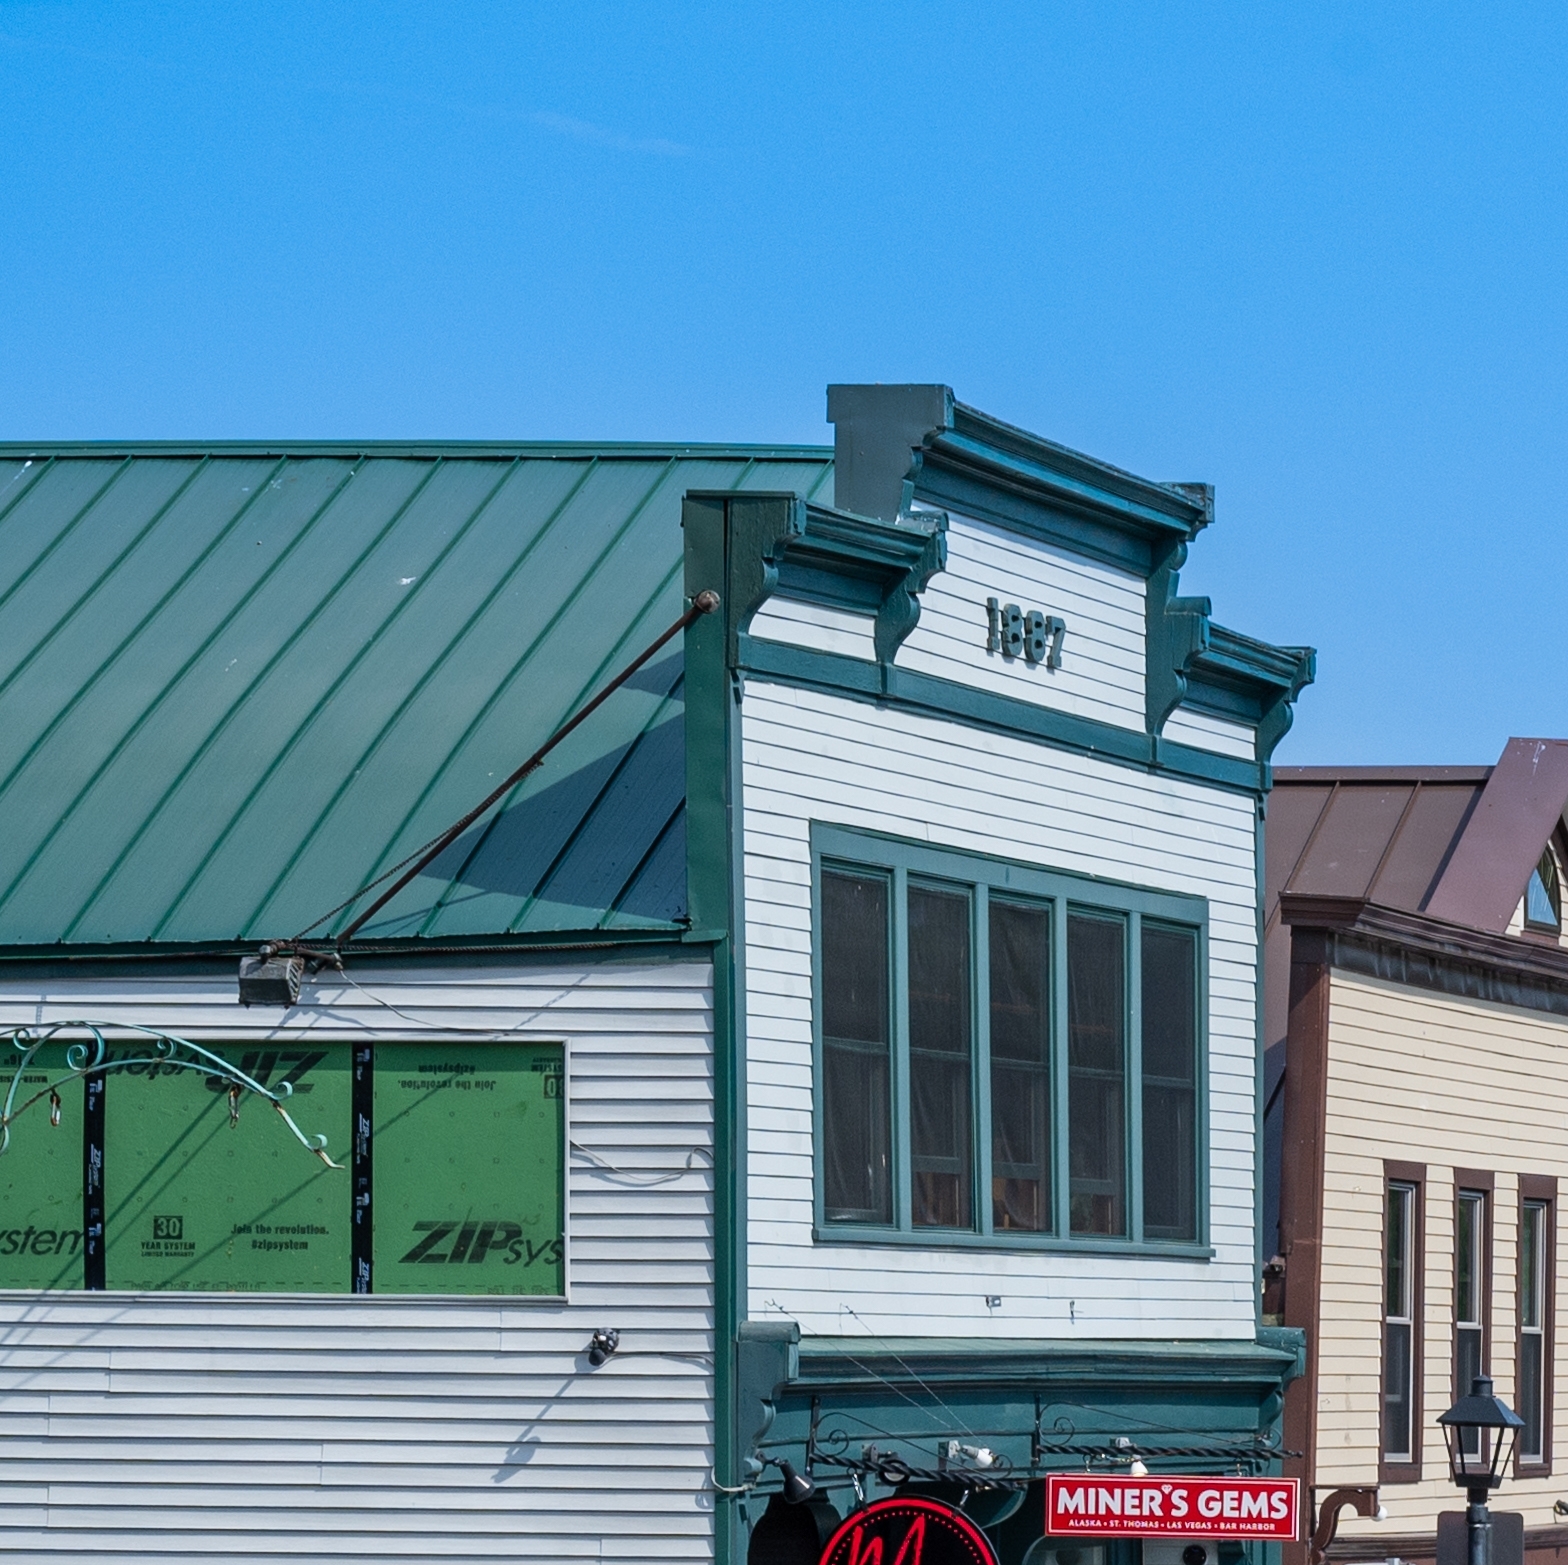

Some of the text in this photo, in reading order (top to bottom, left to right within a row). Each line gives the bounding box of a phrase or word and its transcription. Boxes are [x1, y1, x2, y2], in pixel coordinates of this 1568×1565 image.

[987, 597, 1066, 670] 1887
[157, 1217, 180, 1238] 30
[256, 1224, 272, 1234] the
[141, 1242, 195, 1250] YEAR SYSTEM
[1198, 1490, 1288, 1520] GEMS
[1068, 1519, 1102, 1527] ALASKA
[1123, 1520, 1159, 1529] THOMAS
[1167, 1521, 1182, 1529] LAS
[1185, 1521, 1212, 1530] VEGAS
[1220, 1522, 1237, 1530] BAR
[1239, 1522, 1276, 1531] HARBOR
